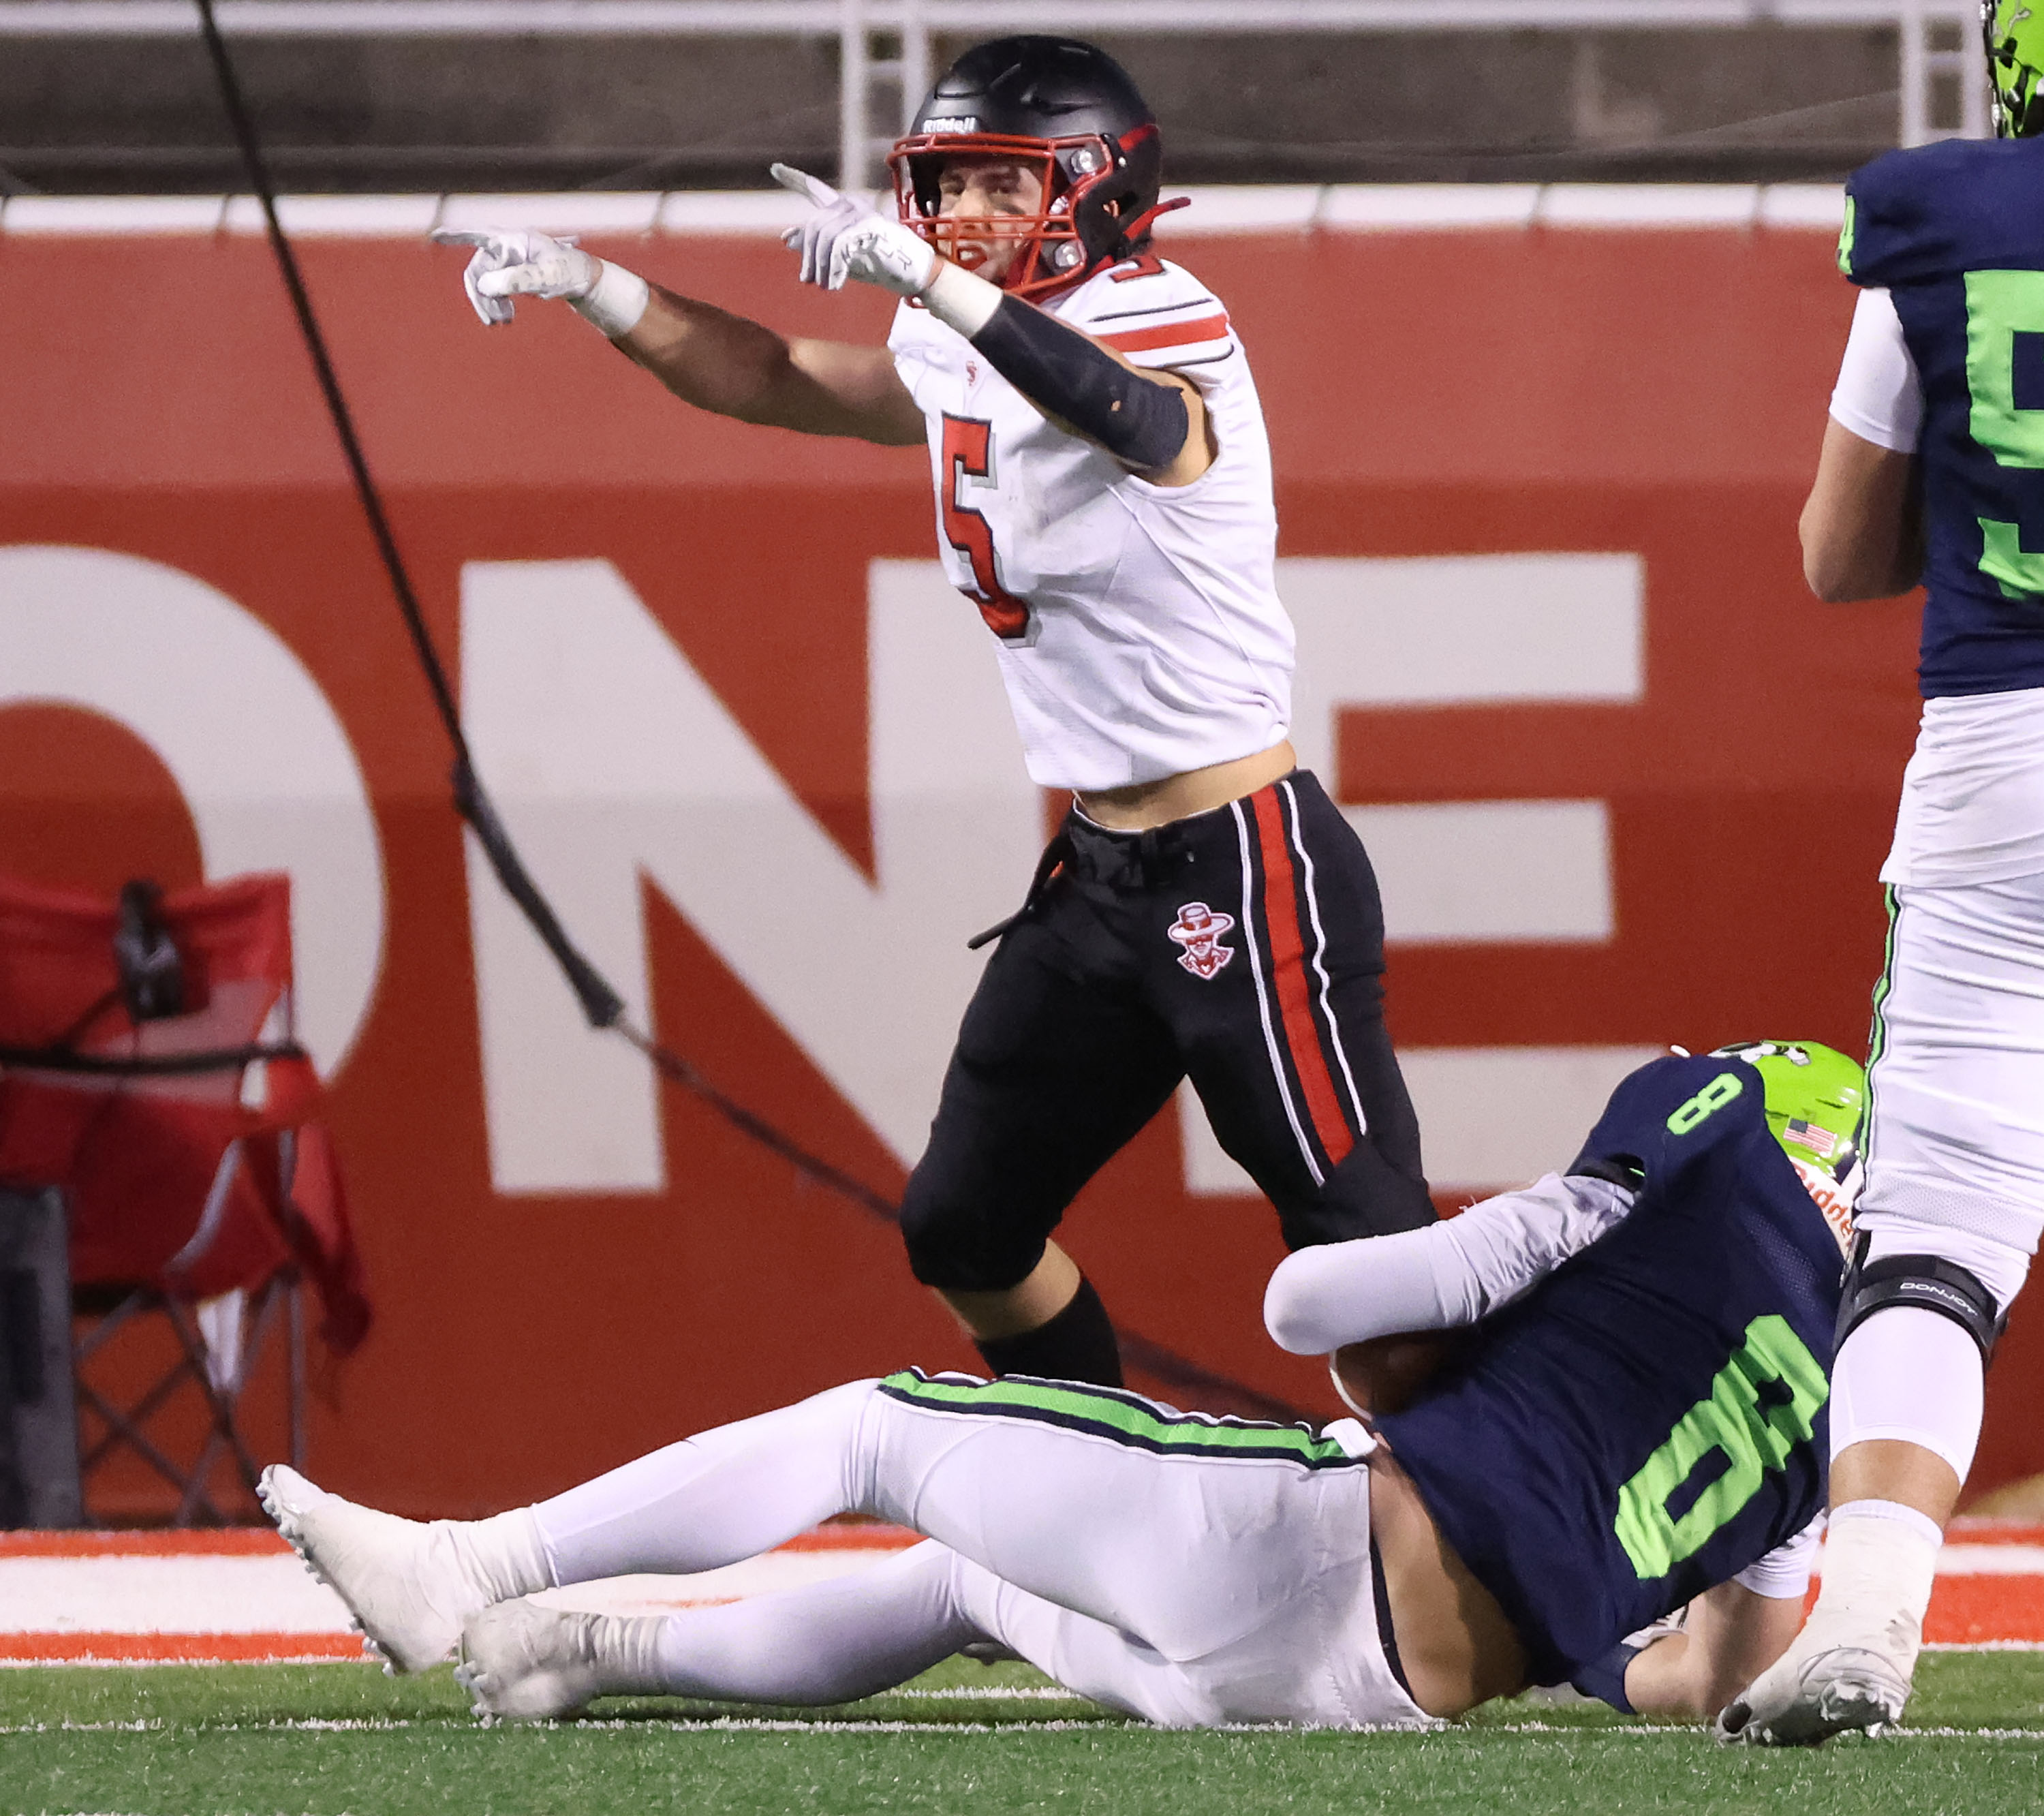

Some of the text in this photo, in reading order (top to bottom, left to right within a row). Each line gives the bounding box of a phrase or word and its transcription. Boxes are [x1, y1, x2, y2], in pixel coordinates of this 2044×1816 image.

[942, 412, 1042, 649] 5
[1667, 1073, 1743, 1135] 8
[1615, 1314, 1829, 1578] 8
